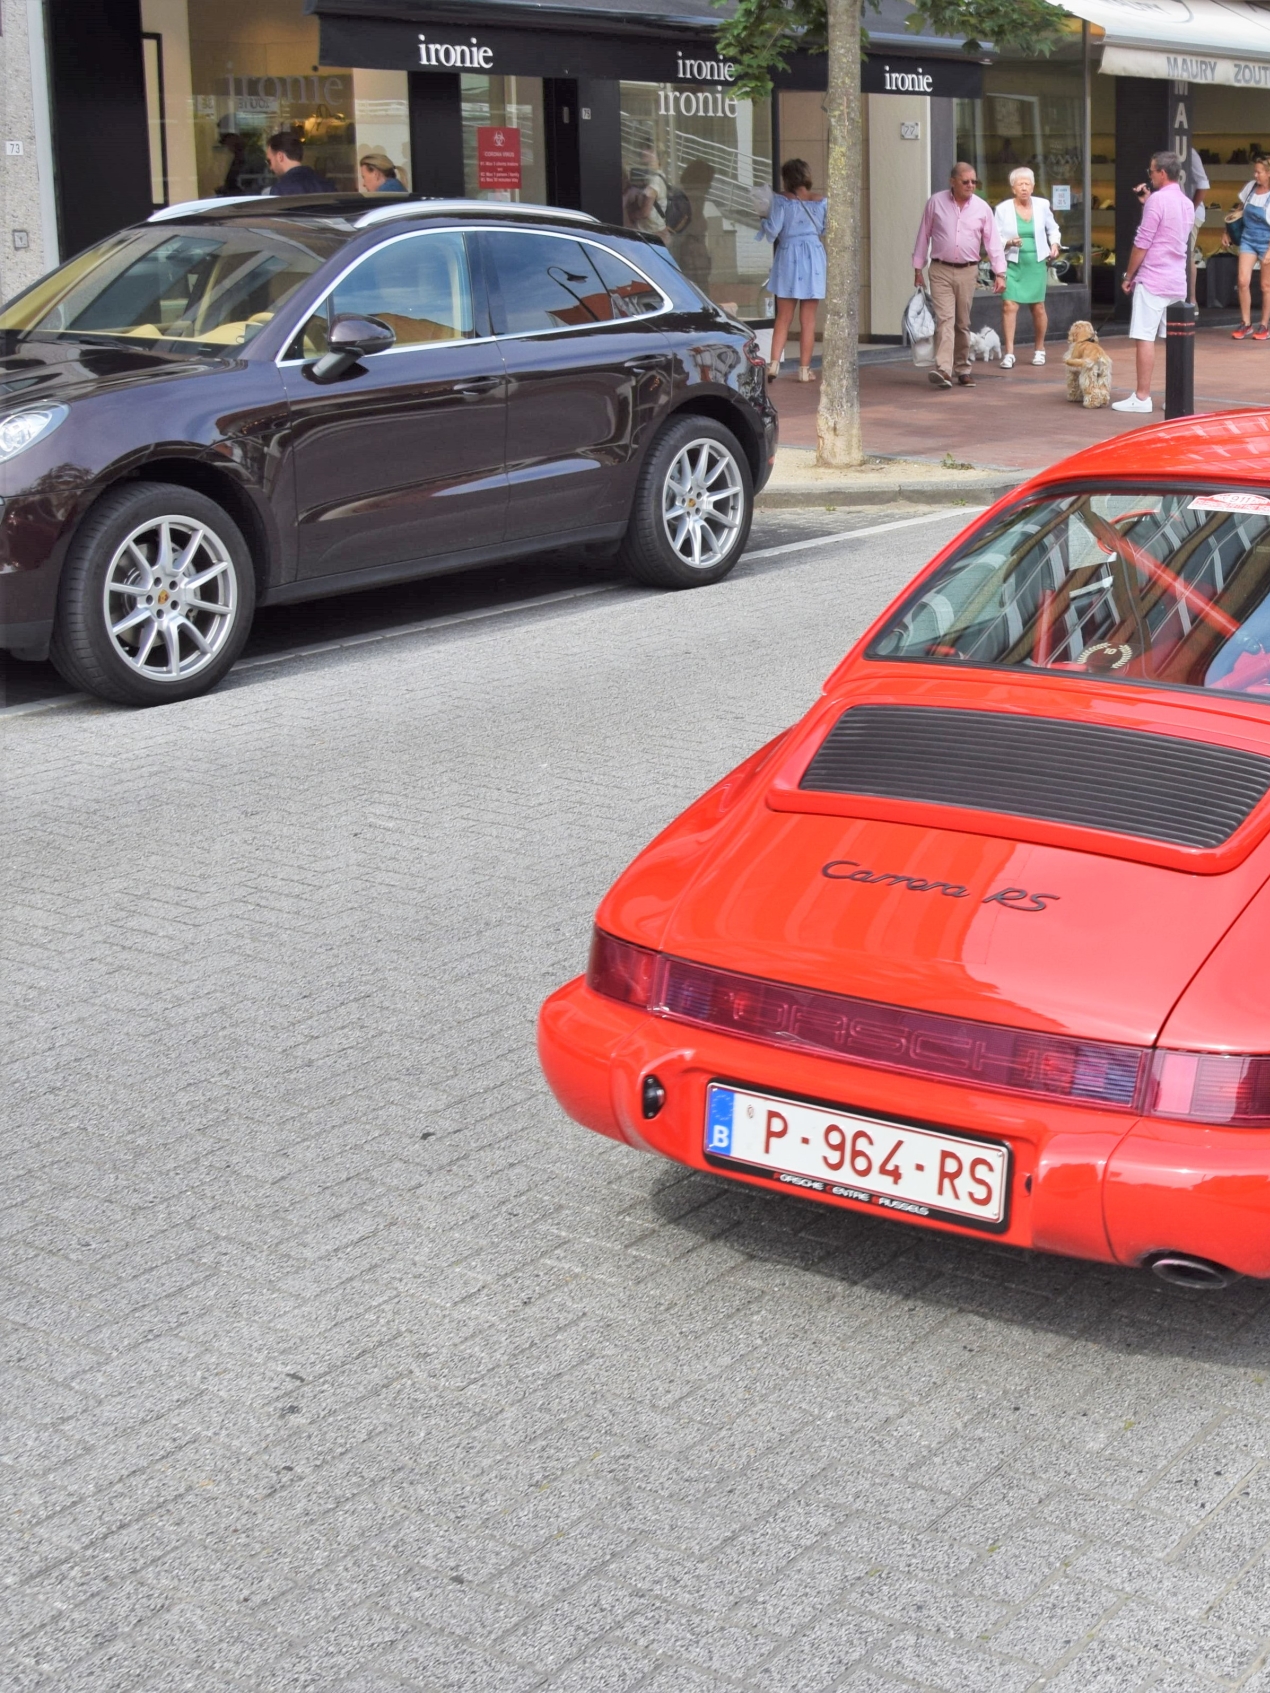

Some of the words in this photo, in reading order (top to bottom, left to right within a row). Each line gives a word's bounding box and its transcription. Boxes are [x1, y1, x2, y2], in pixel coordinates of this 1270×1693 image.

[418, 33, 494, 69] ironie
[676, 50, 736, 82] ironie
[225, 61, 344, 106] ironie
[884, 65, 933, 92] ironie
[1166, 56, 1218, 82] MAURY
[658, 82, 739, 118] ironie
[904, 125, 916, 136] 77
[10, 143, 20, 154] 73
[1229, 495, 1251, 504] 911
[821, 860, 970, 898] Carrera
[981, 887, 1061, 912] RS
[712, 1124, 730, 1148] B
[763, 1109, 995, 1207] P-964-RS
[773, 1172, 824, 1191] PORSCHE
[825, 1184, 871, 1202] CENTRE
[871, 1195, 930, 1216] BRUSSELS
